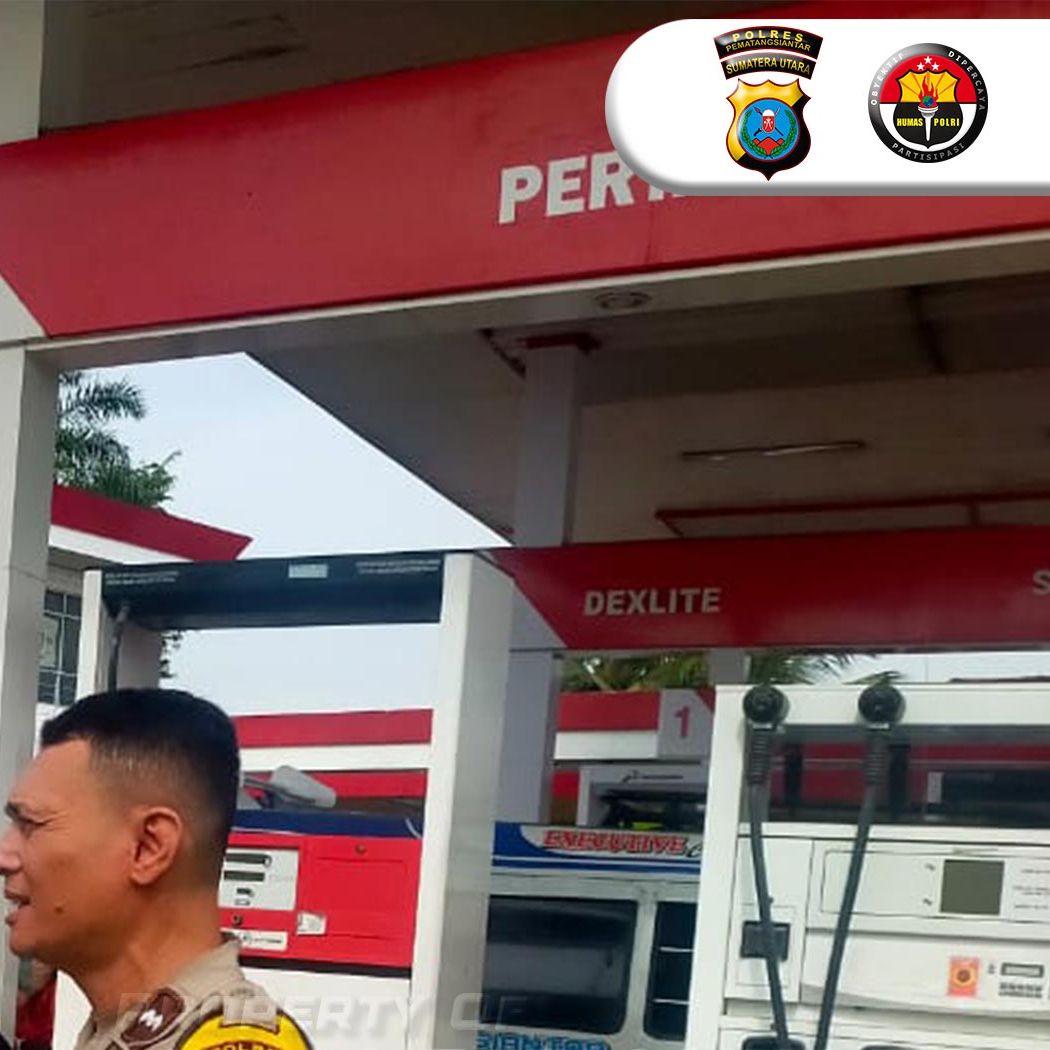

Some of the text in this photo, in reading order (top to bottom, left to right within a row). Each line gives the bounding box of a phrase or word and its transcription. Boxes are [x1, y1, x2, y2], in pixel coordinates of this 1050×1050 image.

[498, 150, 687, 225] PER
[584, 587, 722, 616] DEXLITE
[673, 705, 691, 737] 1
